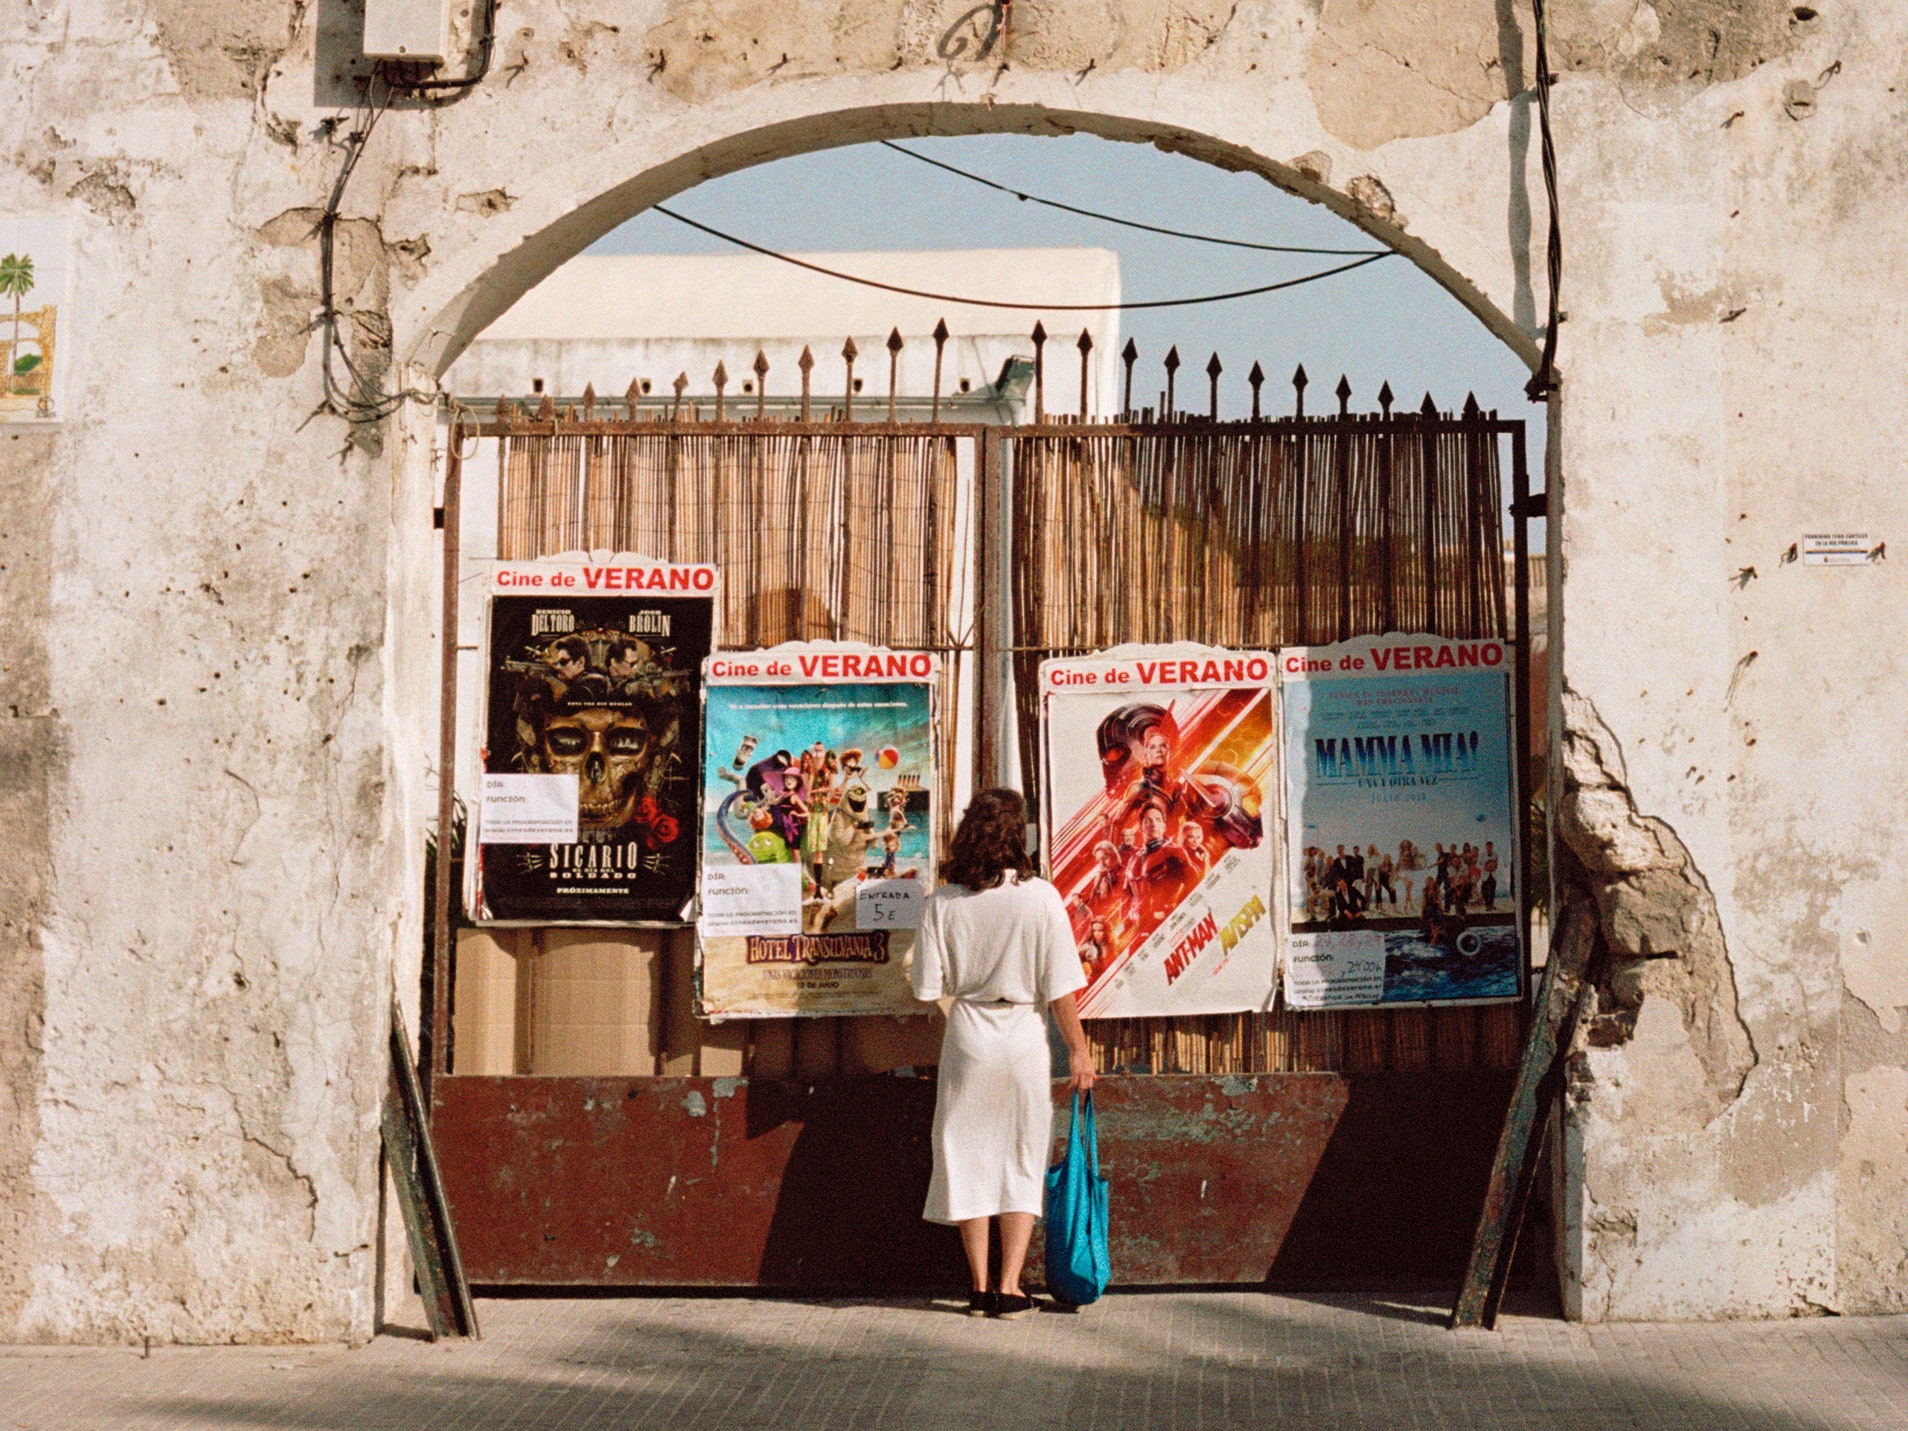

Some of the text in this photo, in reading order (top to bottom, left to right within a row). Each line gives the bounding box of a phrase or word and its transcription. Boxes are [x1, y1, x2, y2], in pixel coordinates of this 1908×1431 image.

[496, 567, 714, 590] Cine de VERANO
[531, 614, 575, 636] DEL TORO
[629, 615, 671, 637] BROLIN
[712, 654, 932, 677] Cine de VERANO
[1050, 657, 1268, 686] Cine de VERANO
[1285, 643, 1503, 672] Cine de VERANO
[1315, 730, 1479, 777] MAMMA MIA!
[1389, 776, 1416, 787] OTRA
[1420, 775, 1438, 786] VEZ
[549, 842, 638, 870] SICARIO
[860, 891, 910, 900] ENTRADA
[1219, 894, 1267, 956] AVISPA
[750, 932, 886, 963] HOTEL TRANSILVANIA 3
[1163, 911, 1218, 986] ANT-MAN
